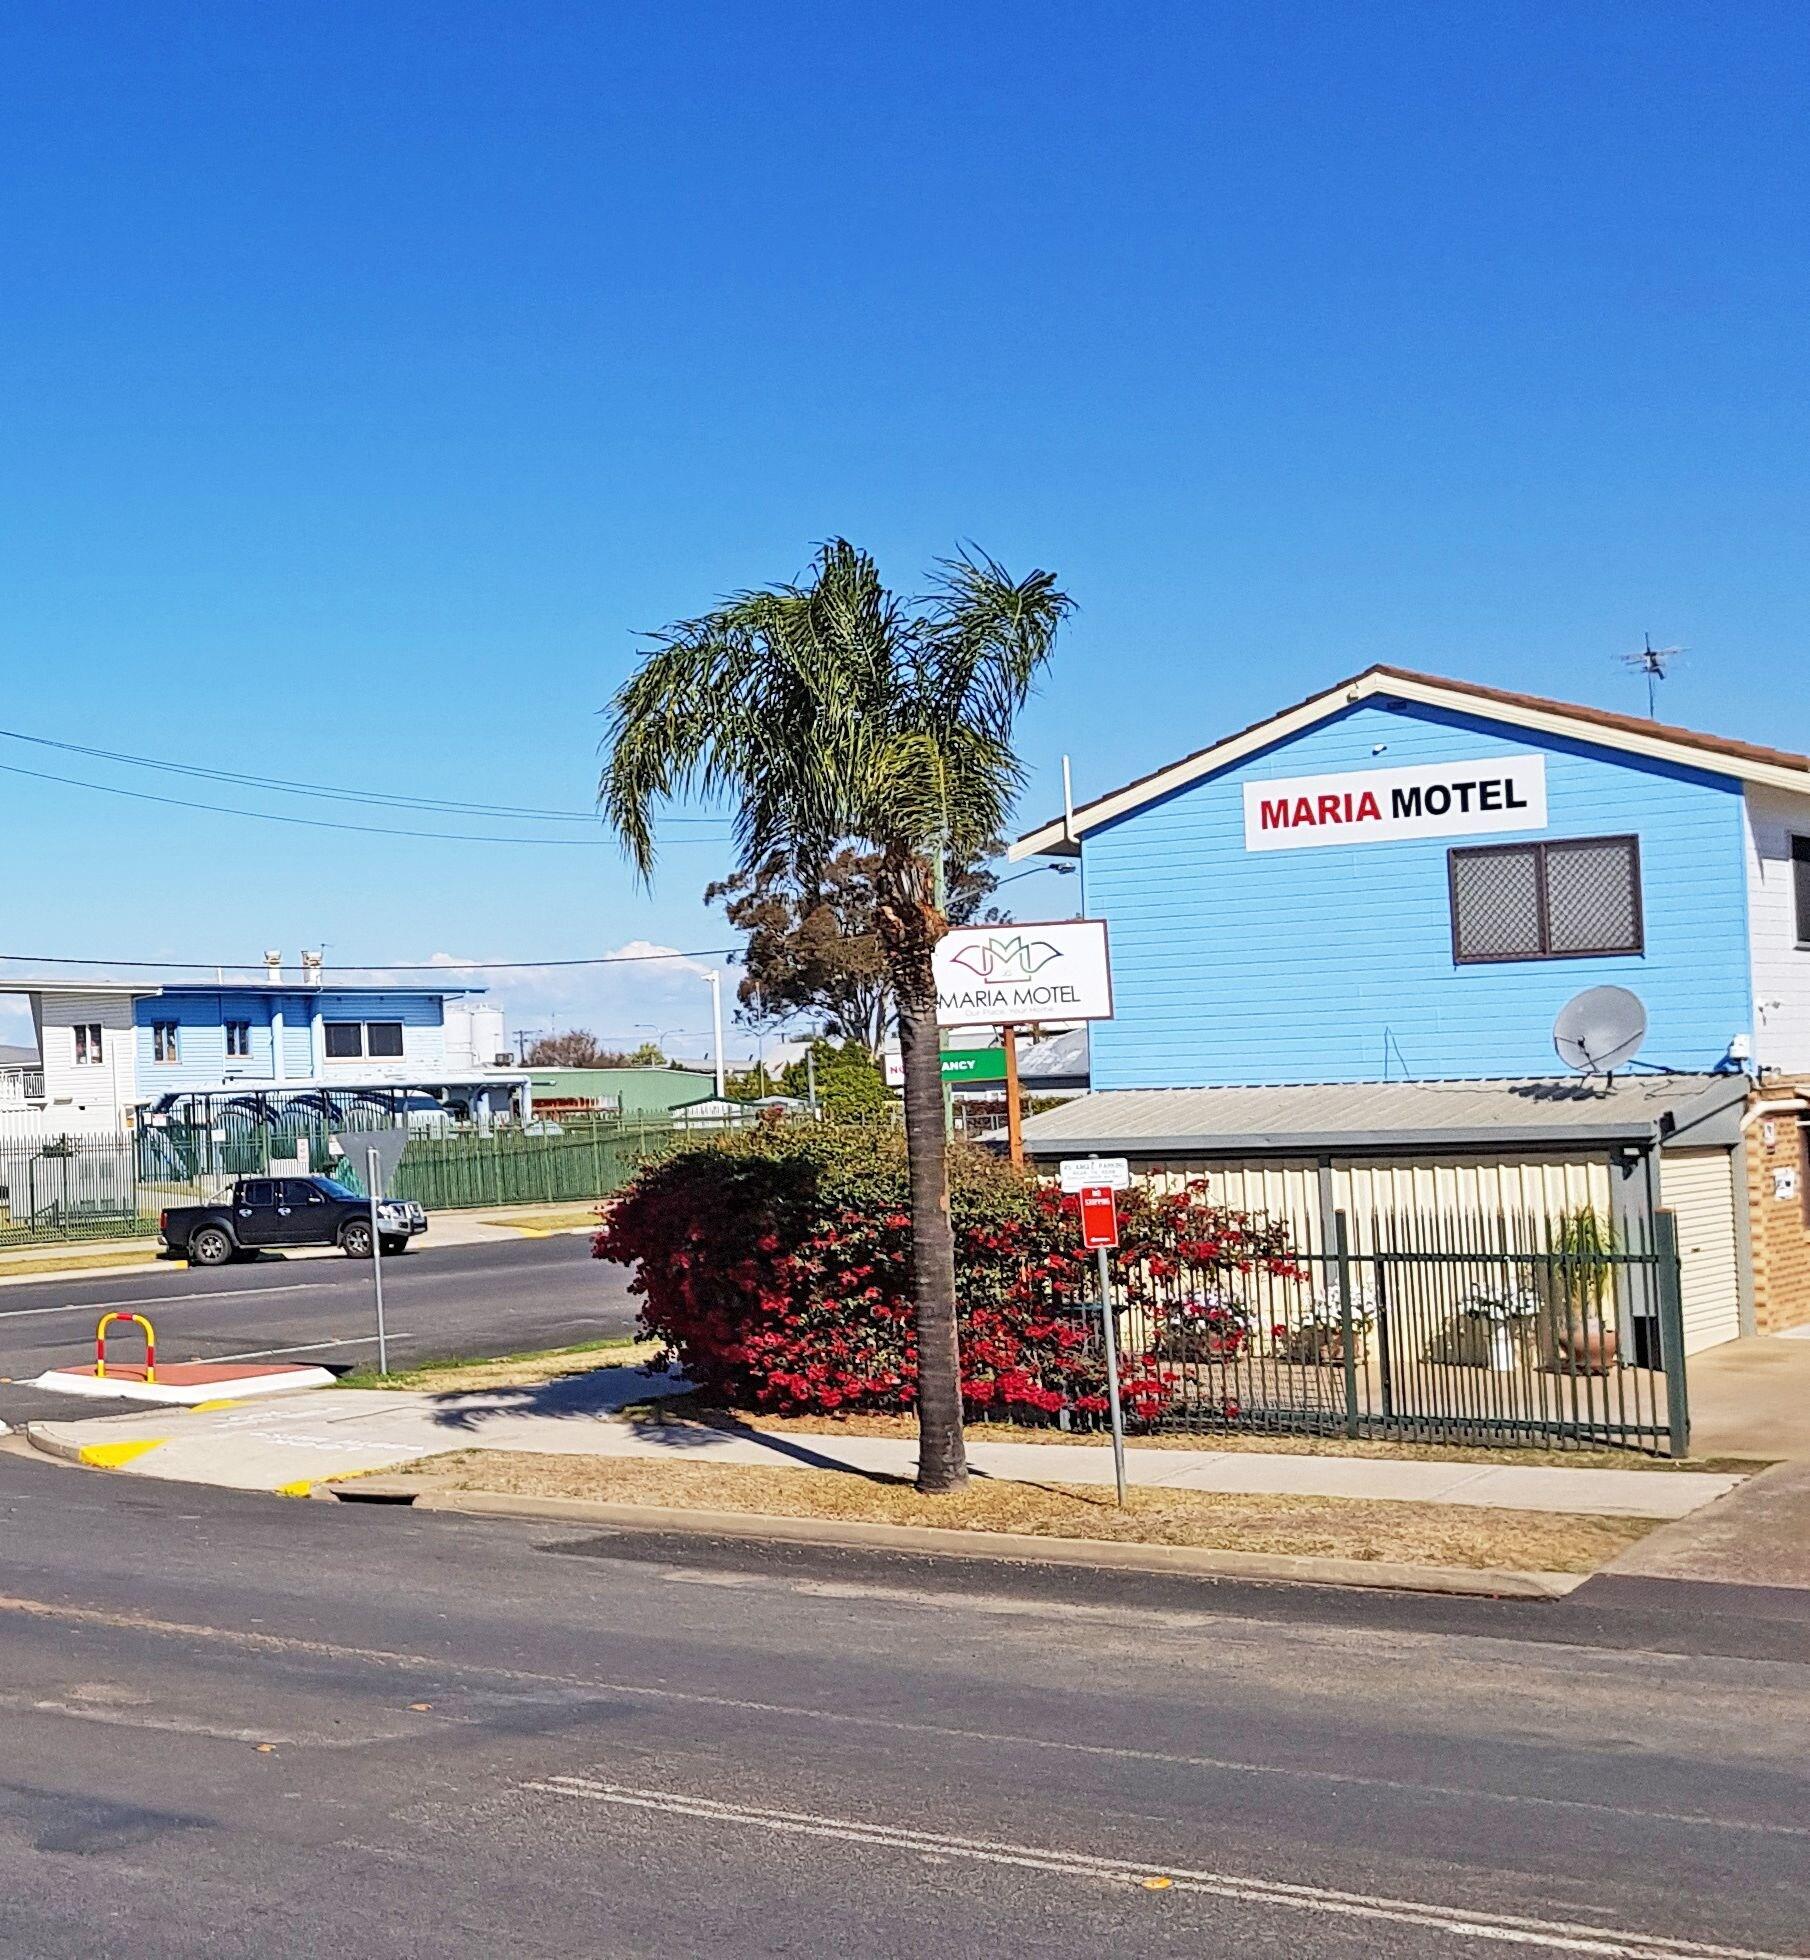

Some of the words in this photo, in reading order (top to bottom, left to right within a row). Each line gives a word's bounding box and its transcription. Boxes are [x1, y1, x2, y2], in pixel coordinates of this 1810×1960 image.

[1260, 791, 1382, 830] MARIA
[1391, 778, 1527, 818] MOTEL
[938, 990, 1008, 1009] MARIA
[1013, 986, 1082, 1006] MOTEL
[941, 1060, 976, 1072] ANCY
